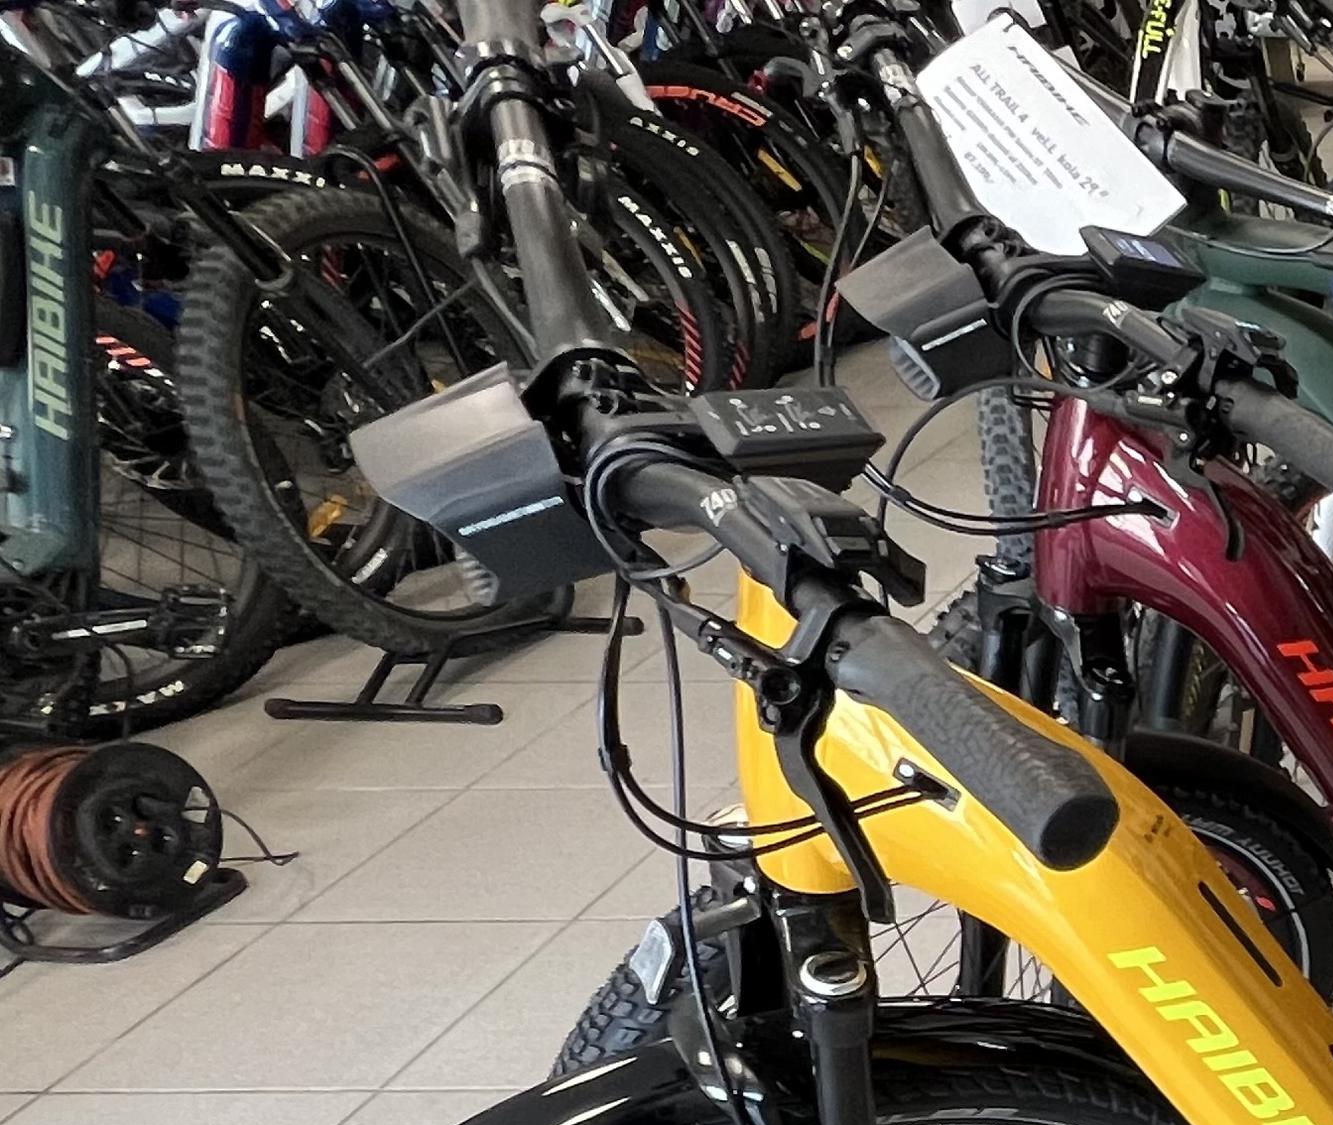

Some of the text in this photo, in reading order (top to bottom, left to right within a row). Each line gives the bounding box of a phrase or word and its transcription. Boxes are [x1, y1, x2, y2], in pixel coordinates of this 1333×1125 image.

[968, 61, 992, 84] ALL
[629, 116, 700, 156] AXXIS
[28, 190, 71, 441] HAIBIKE
